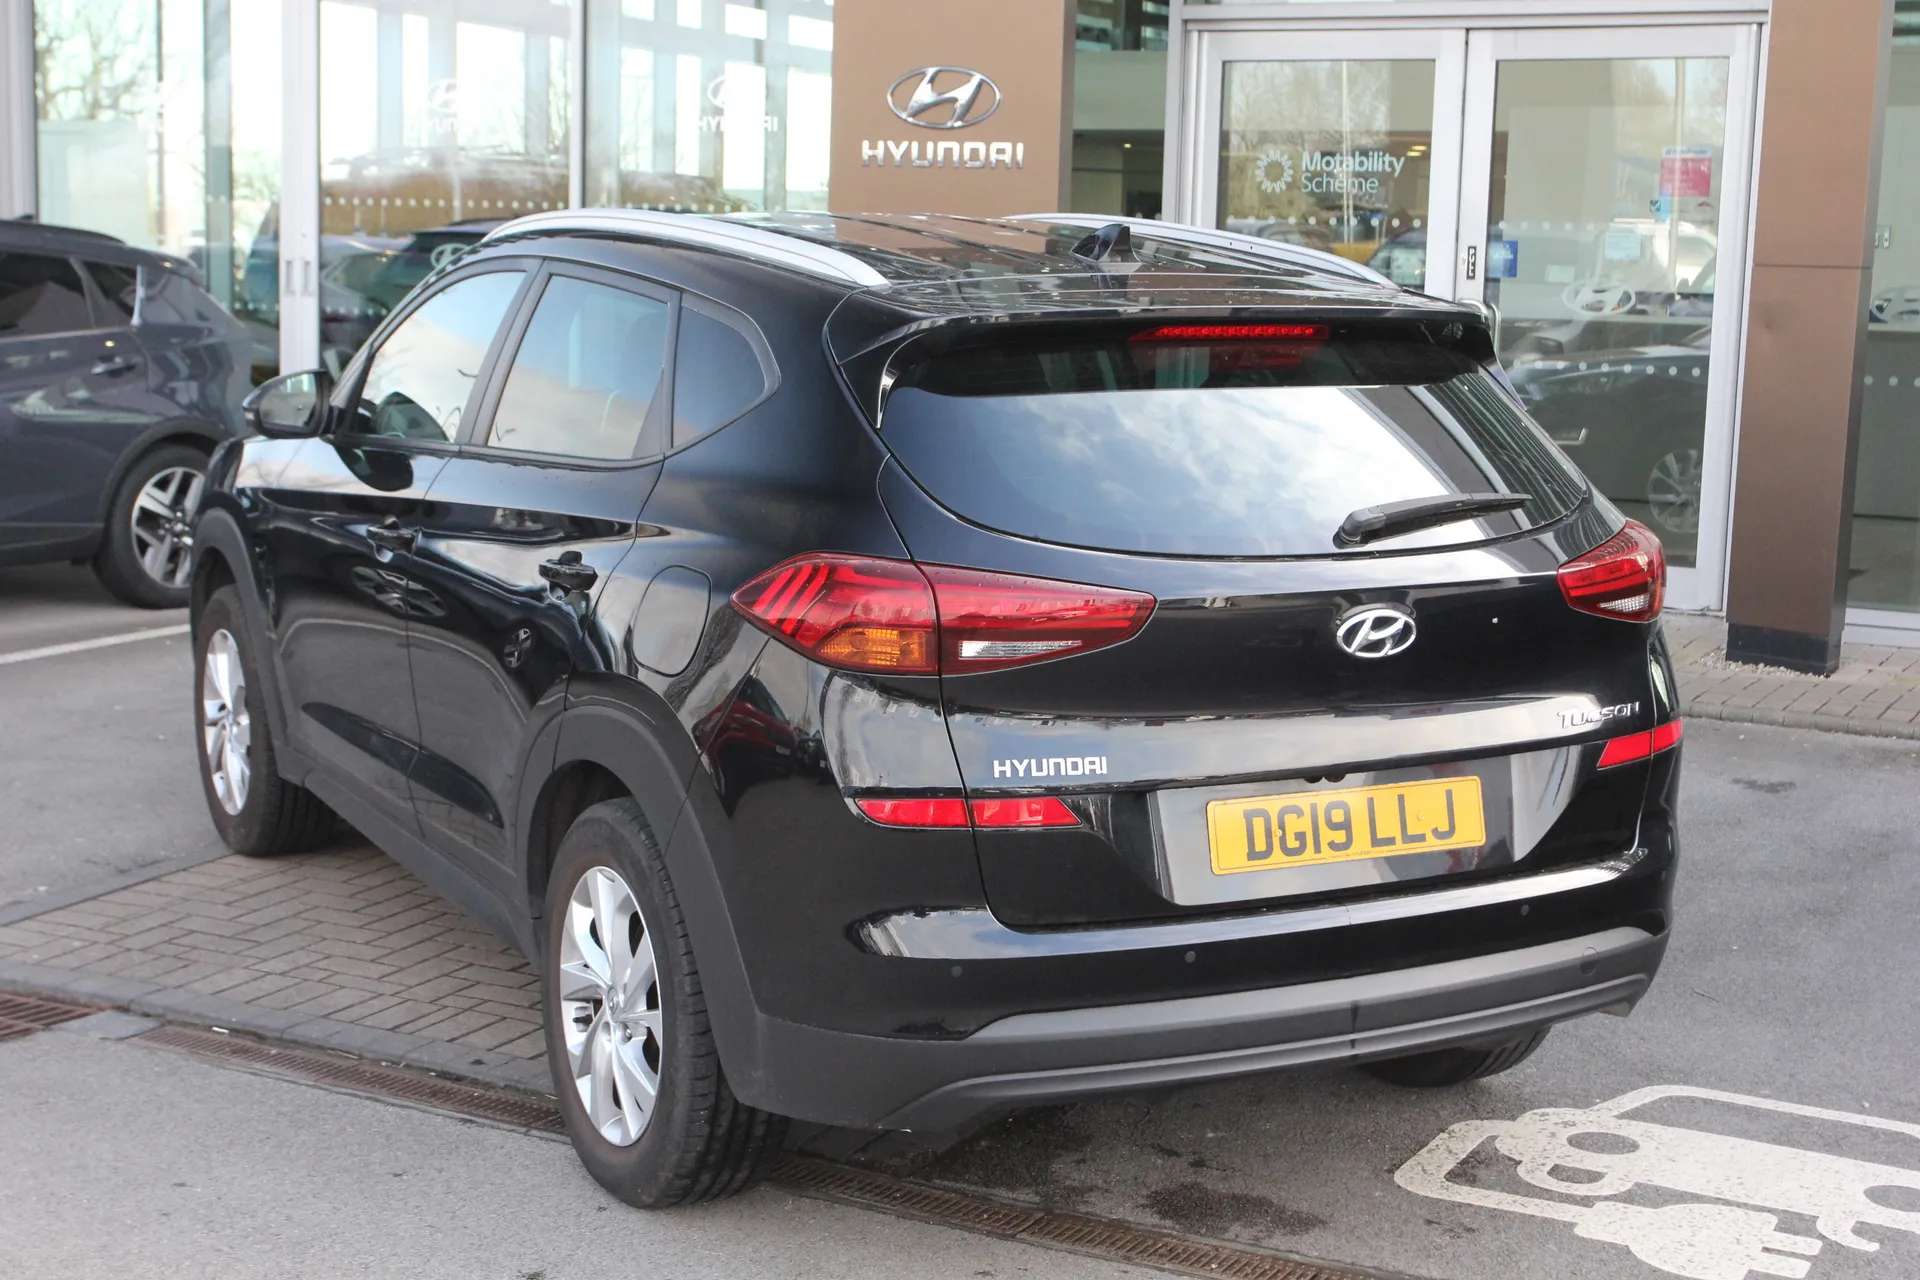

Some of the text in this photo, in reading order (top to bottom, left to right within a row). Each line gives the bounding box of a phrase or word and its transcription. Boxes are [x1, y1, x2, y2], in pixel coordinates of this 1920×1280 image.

[861, 140, 1025, 169] HYUNDAI
[1301, 151, 1405, 178] Motability
[1301, 172, 1379, 193] Scheme
[993, 756, 1108, 778] HYUNDAI
[1243, 789, 1456, 862] DG19 LLJ
